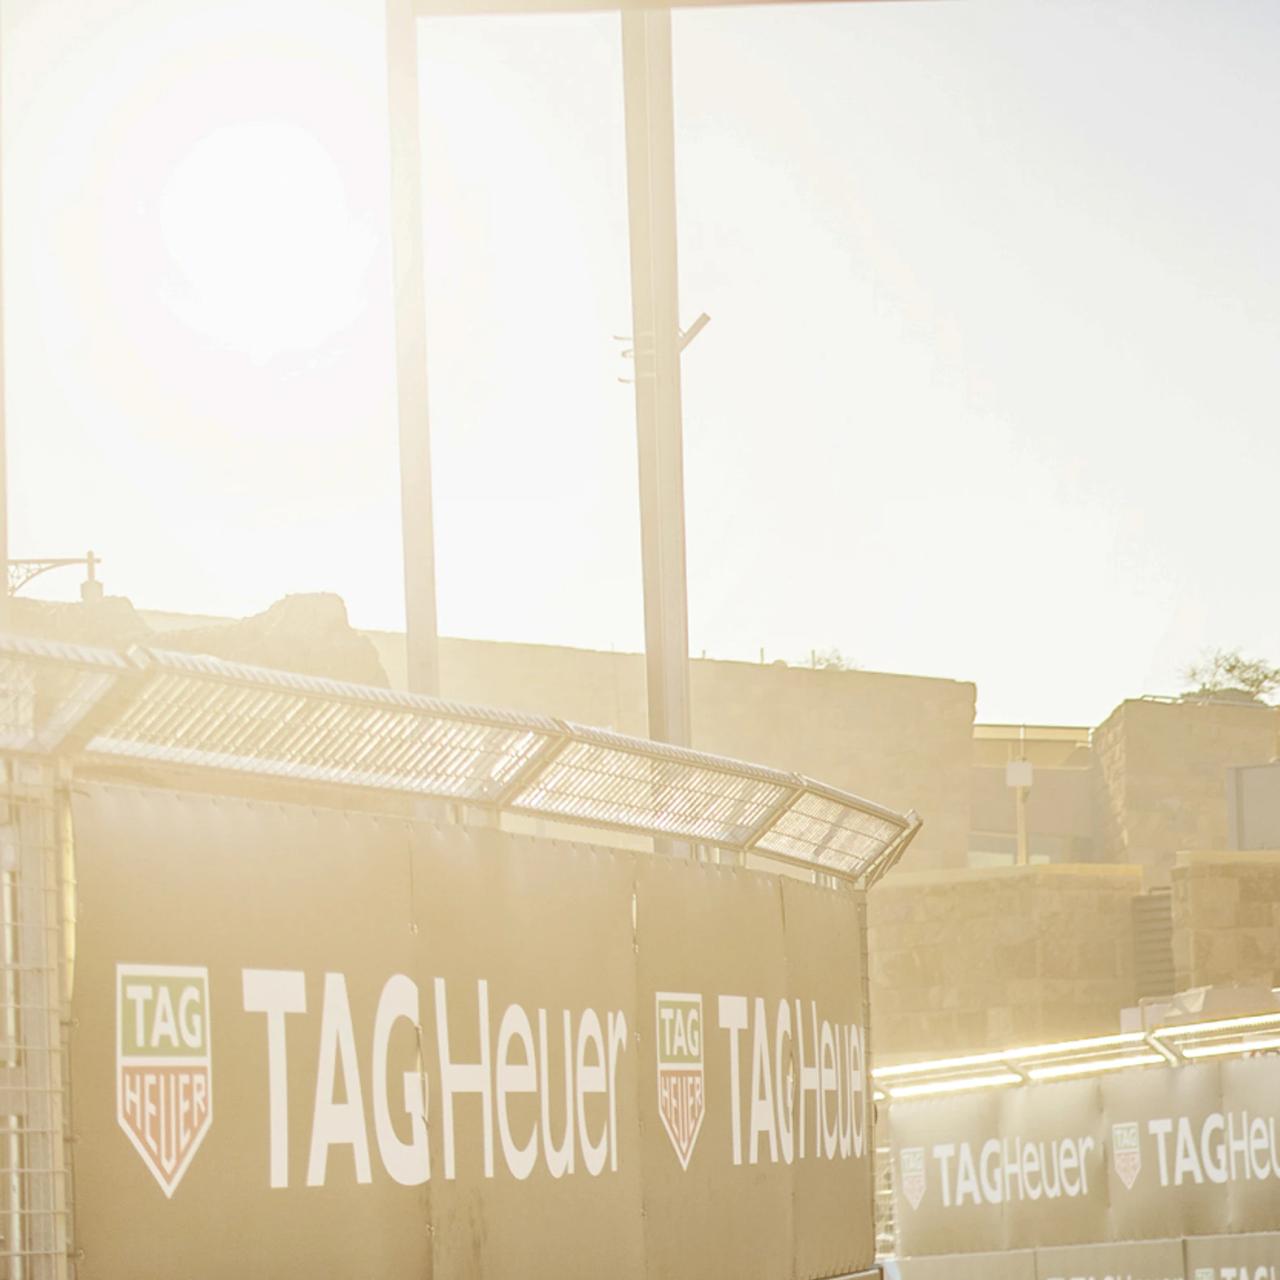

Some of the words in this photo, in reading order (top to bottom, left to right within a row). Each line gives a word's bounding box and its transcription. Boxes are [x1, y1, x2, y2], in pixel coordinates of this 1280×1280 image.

[126, 985, 202, 1049] TAG
[660, 1008, 699, 1057] TAG
[125, 1073, 208, 1169] HEUER
[660, 1076, 701, 1153] HEUER
